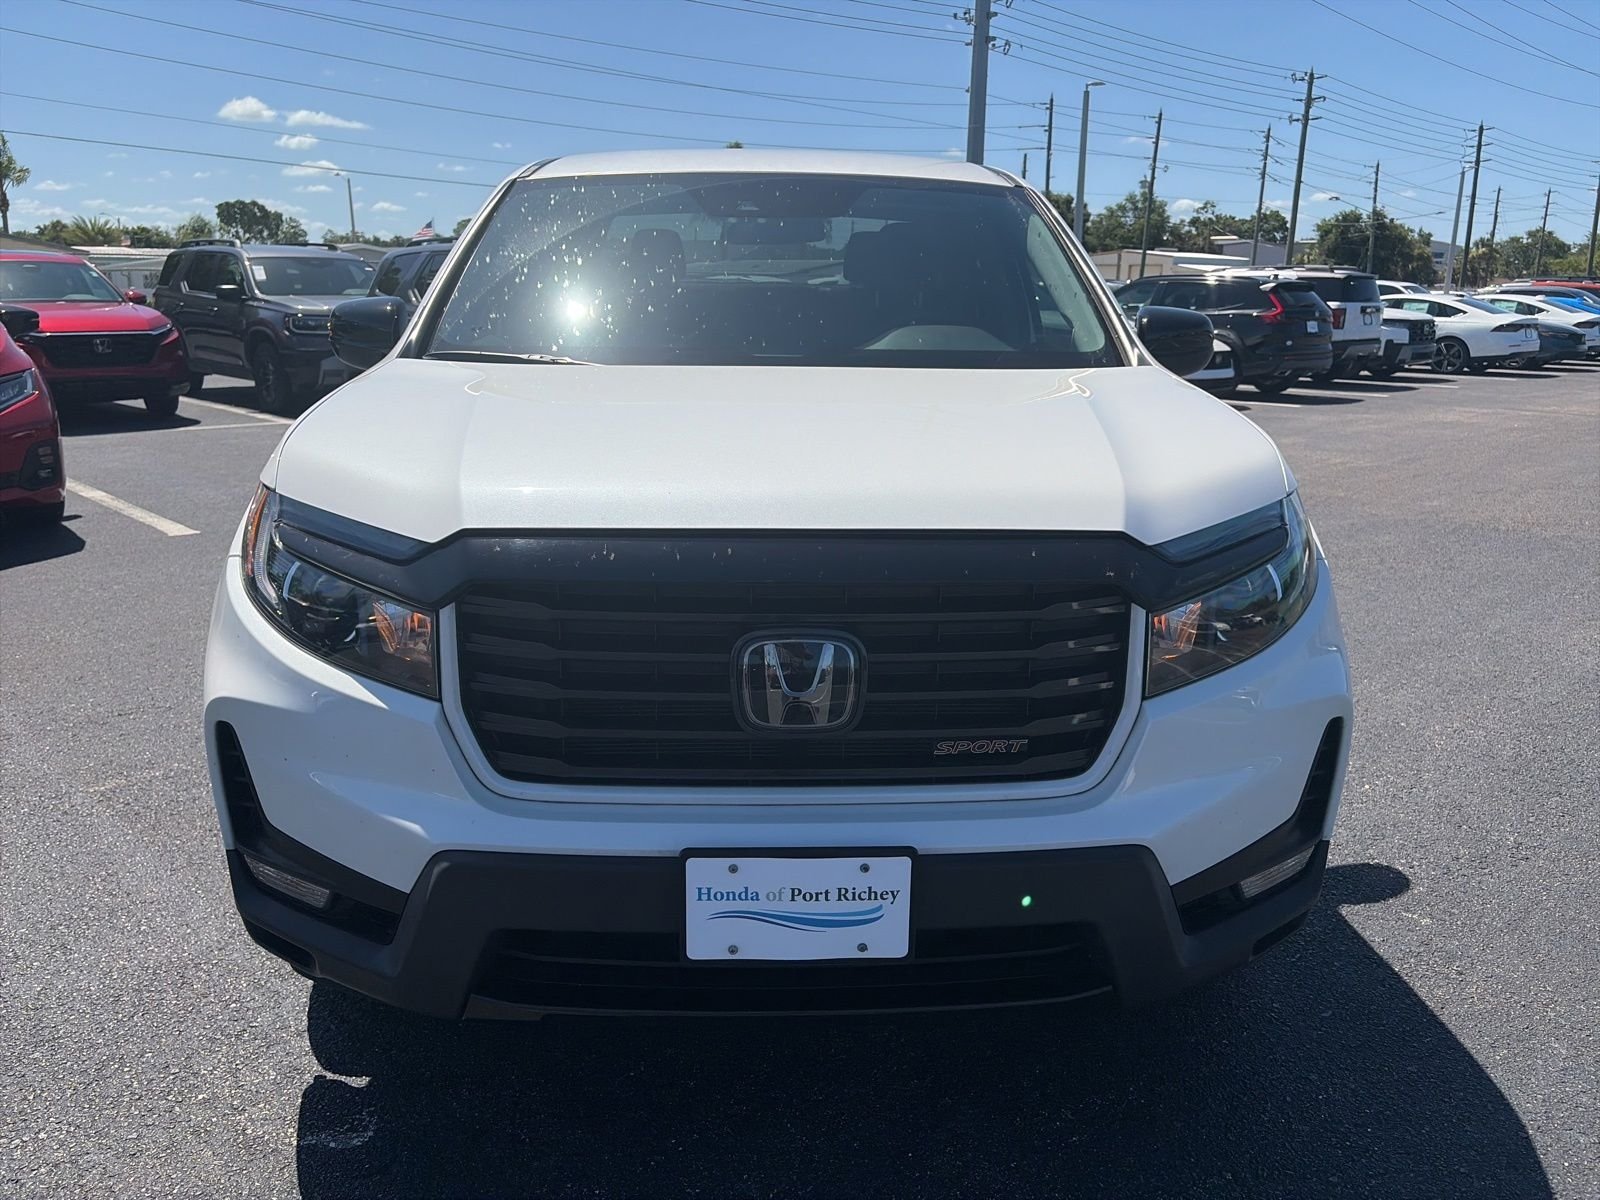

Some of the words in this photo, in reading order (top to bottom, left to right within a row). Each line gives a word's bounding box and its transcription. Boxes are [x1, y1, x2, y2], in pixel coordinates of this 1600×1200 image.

[933, 739, 1028, 755] SPORT
[696, 887, 760, 902] Honda
[765, 887, 786, 902] of
[789, 887, 831, 902] Port
[836, 886, 901, 905] Richey
